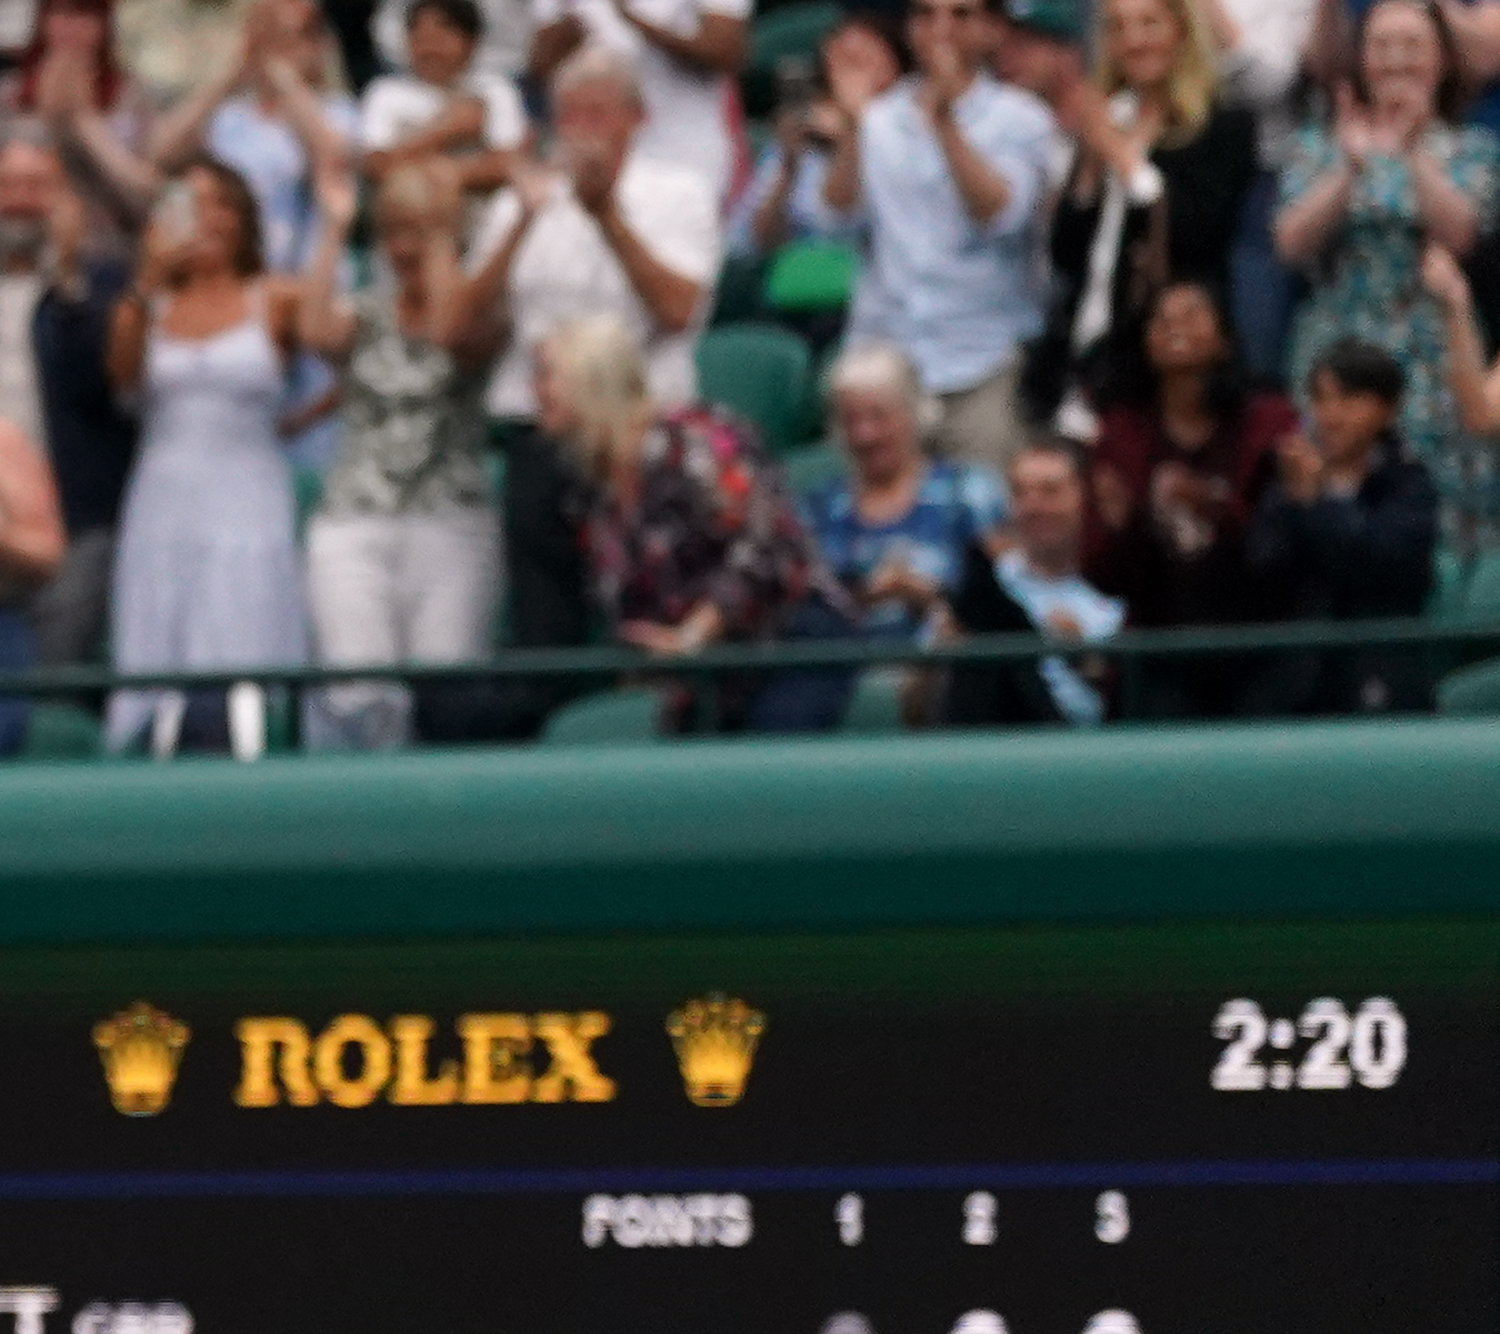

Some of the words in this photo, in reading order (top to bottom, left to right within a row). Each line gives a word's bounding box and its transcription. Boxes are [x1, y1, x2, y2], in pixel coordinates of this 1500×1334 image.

[235, 1010, 616, 1109] ROLEX
[1210, 996, 1408, 1092] 2:20
[582, 1192, 753, 1248] POINTS
[835, 1192, 864, 1247] 1
[962, 1191, 998, 1246] 2
[1094, 1189, 1130, 1244] 3
